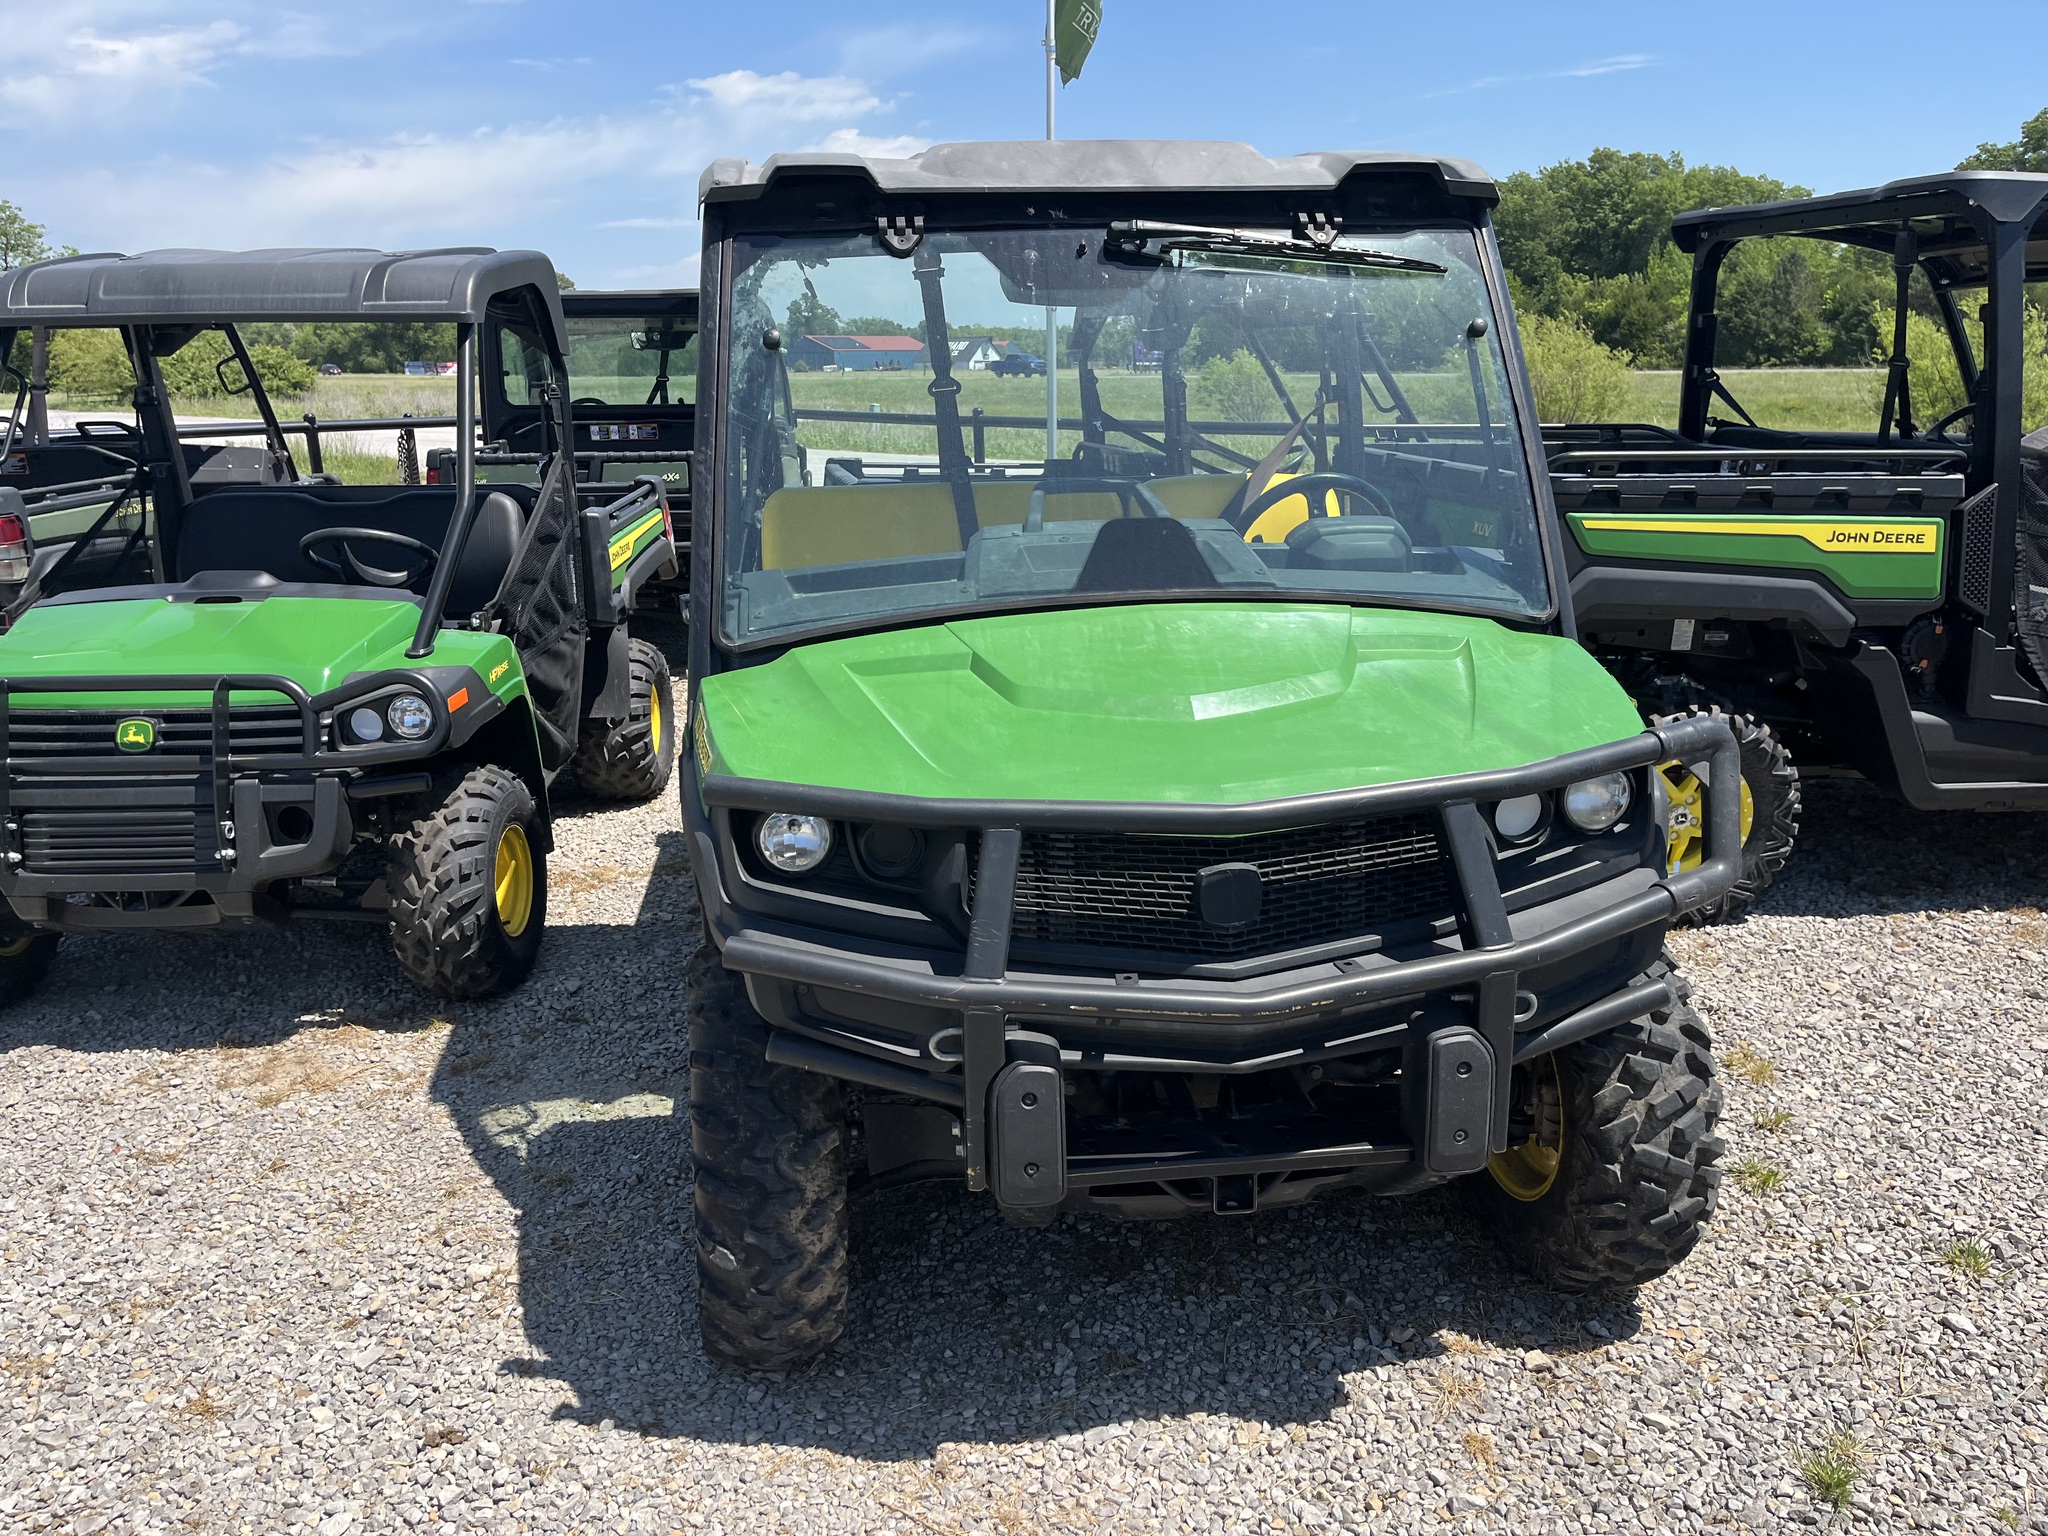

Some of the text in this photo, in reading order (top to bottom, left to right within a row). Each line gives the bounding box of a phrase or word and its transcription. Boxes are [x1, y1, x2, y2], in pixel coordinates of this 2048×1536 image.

[947, 341, 970, 351] UARD
[132, 502, 154, 514] DERE
[1826, 530, 1926, 544] JOHN DEERE
